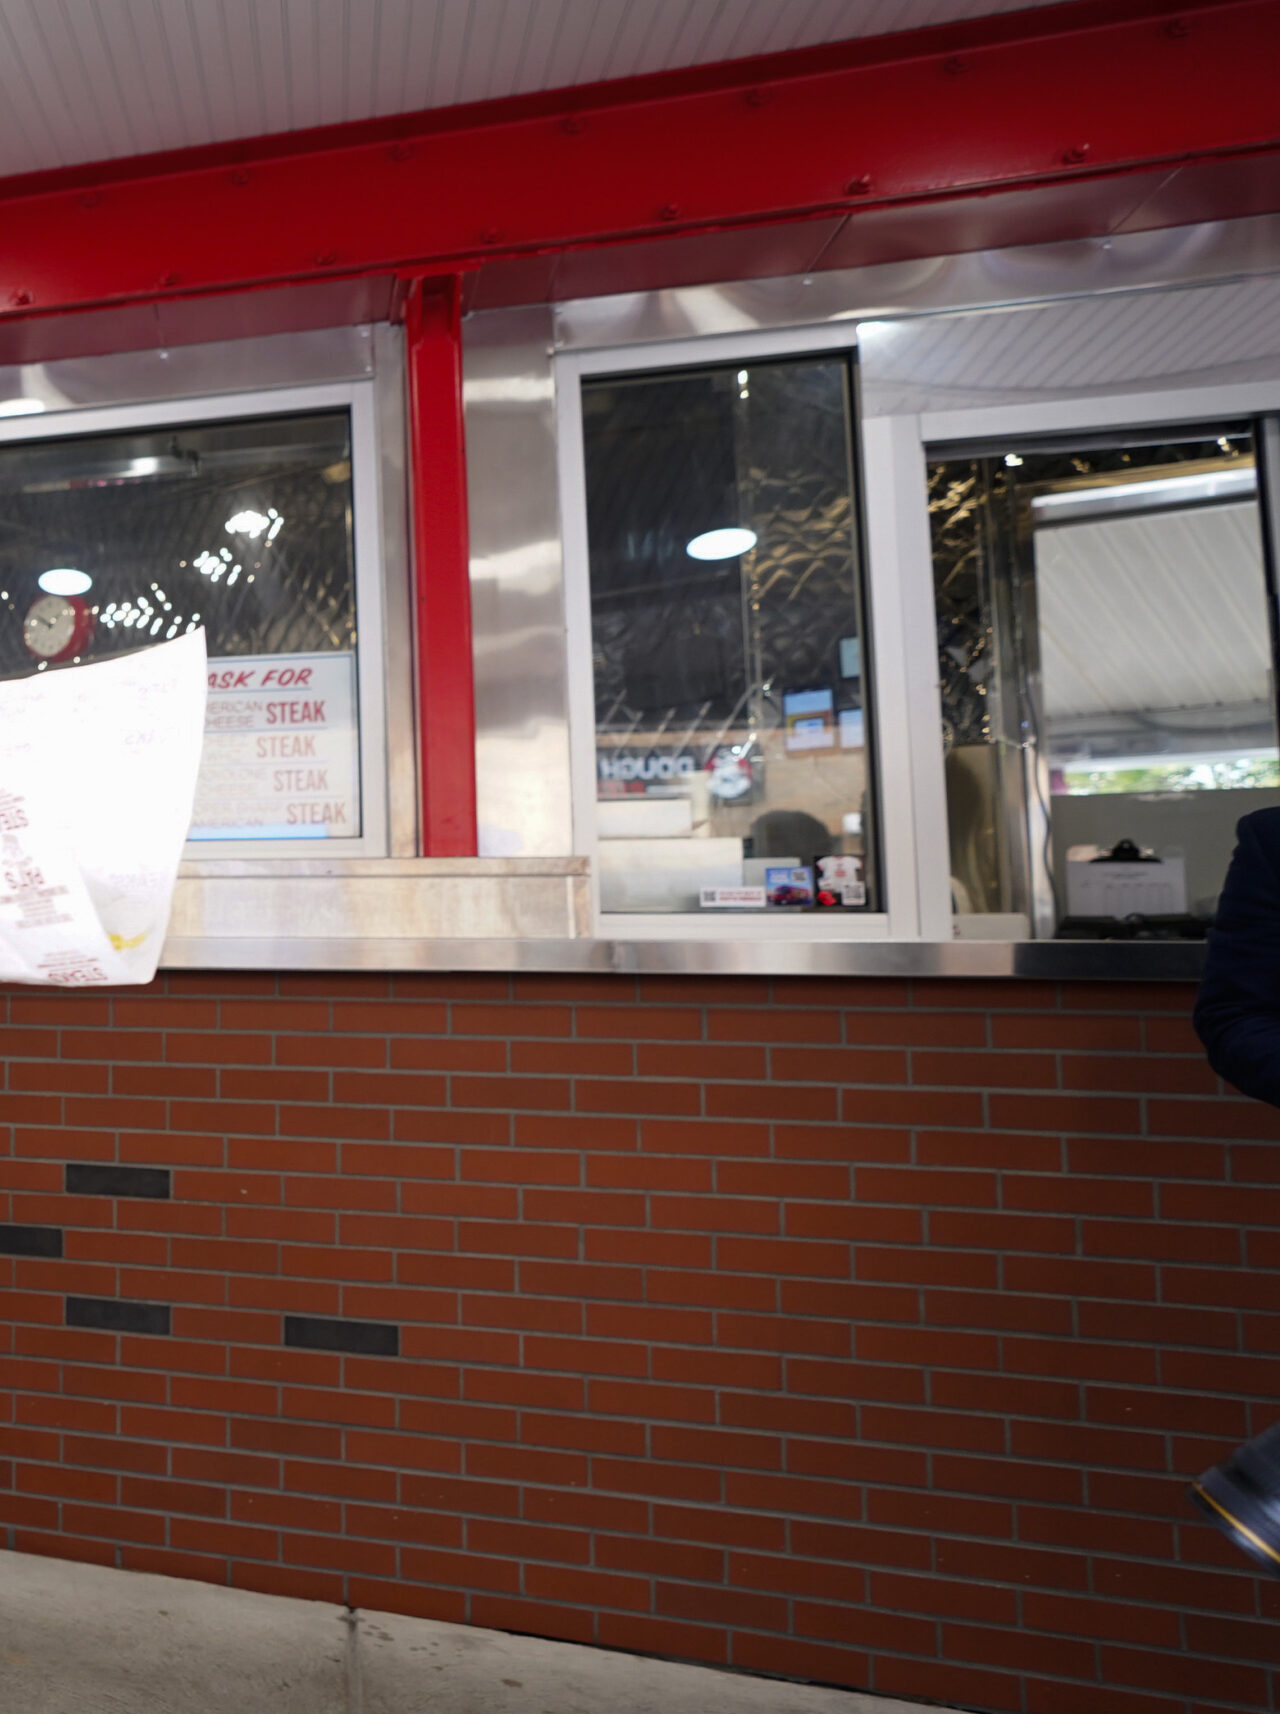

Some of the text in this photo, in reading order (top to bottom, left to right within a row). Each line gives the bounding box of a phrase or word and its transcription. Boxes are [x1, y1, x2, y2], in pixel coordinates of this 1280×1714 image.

[207, 667, 313, 689] ASK FOR
[206, 701, 263, 715] ERICAN
[266, 700, 326, 724] STEAK
[205, 715, 254, 728] HEESE
[256, 735, 316, 758] STEAK
[273, 769, 328, 792] STEAK
[286, 802, 346, 825] STEAK
